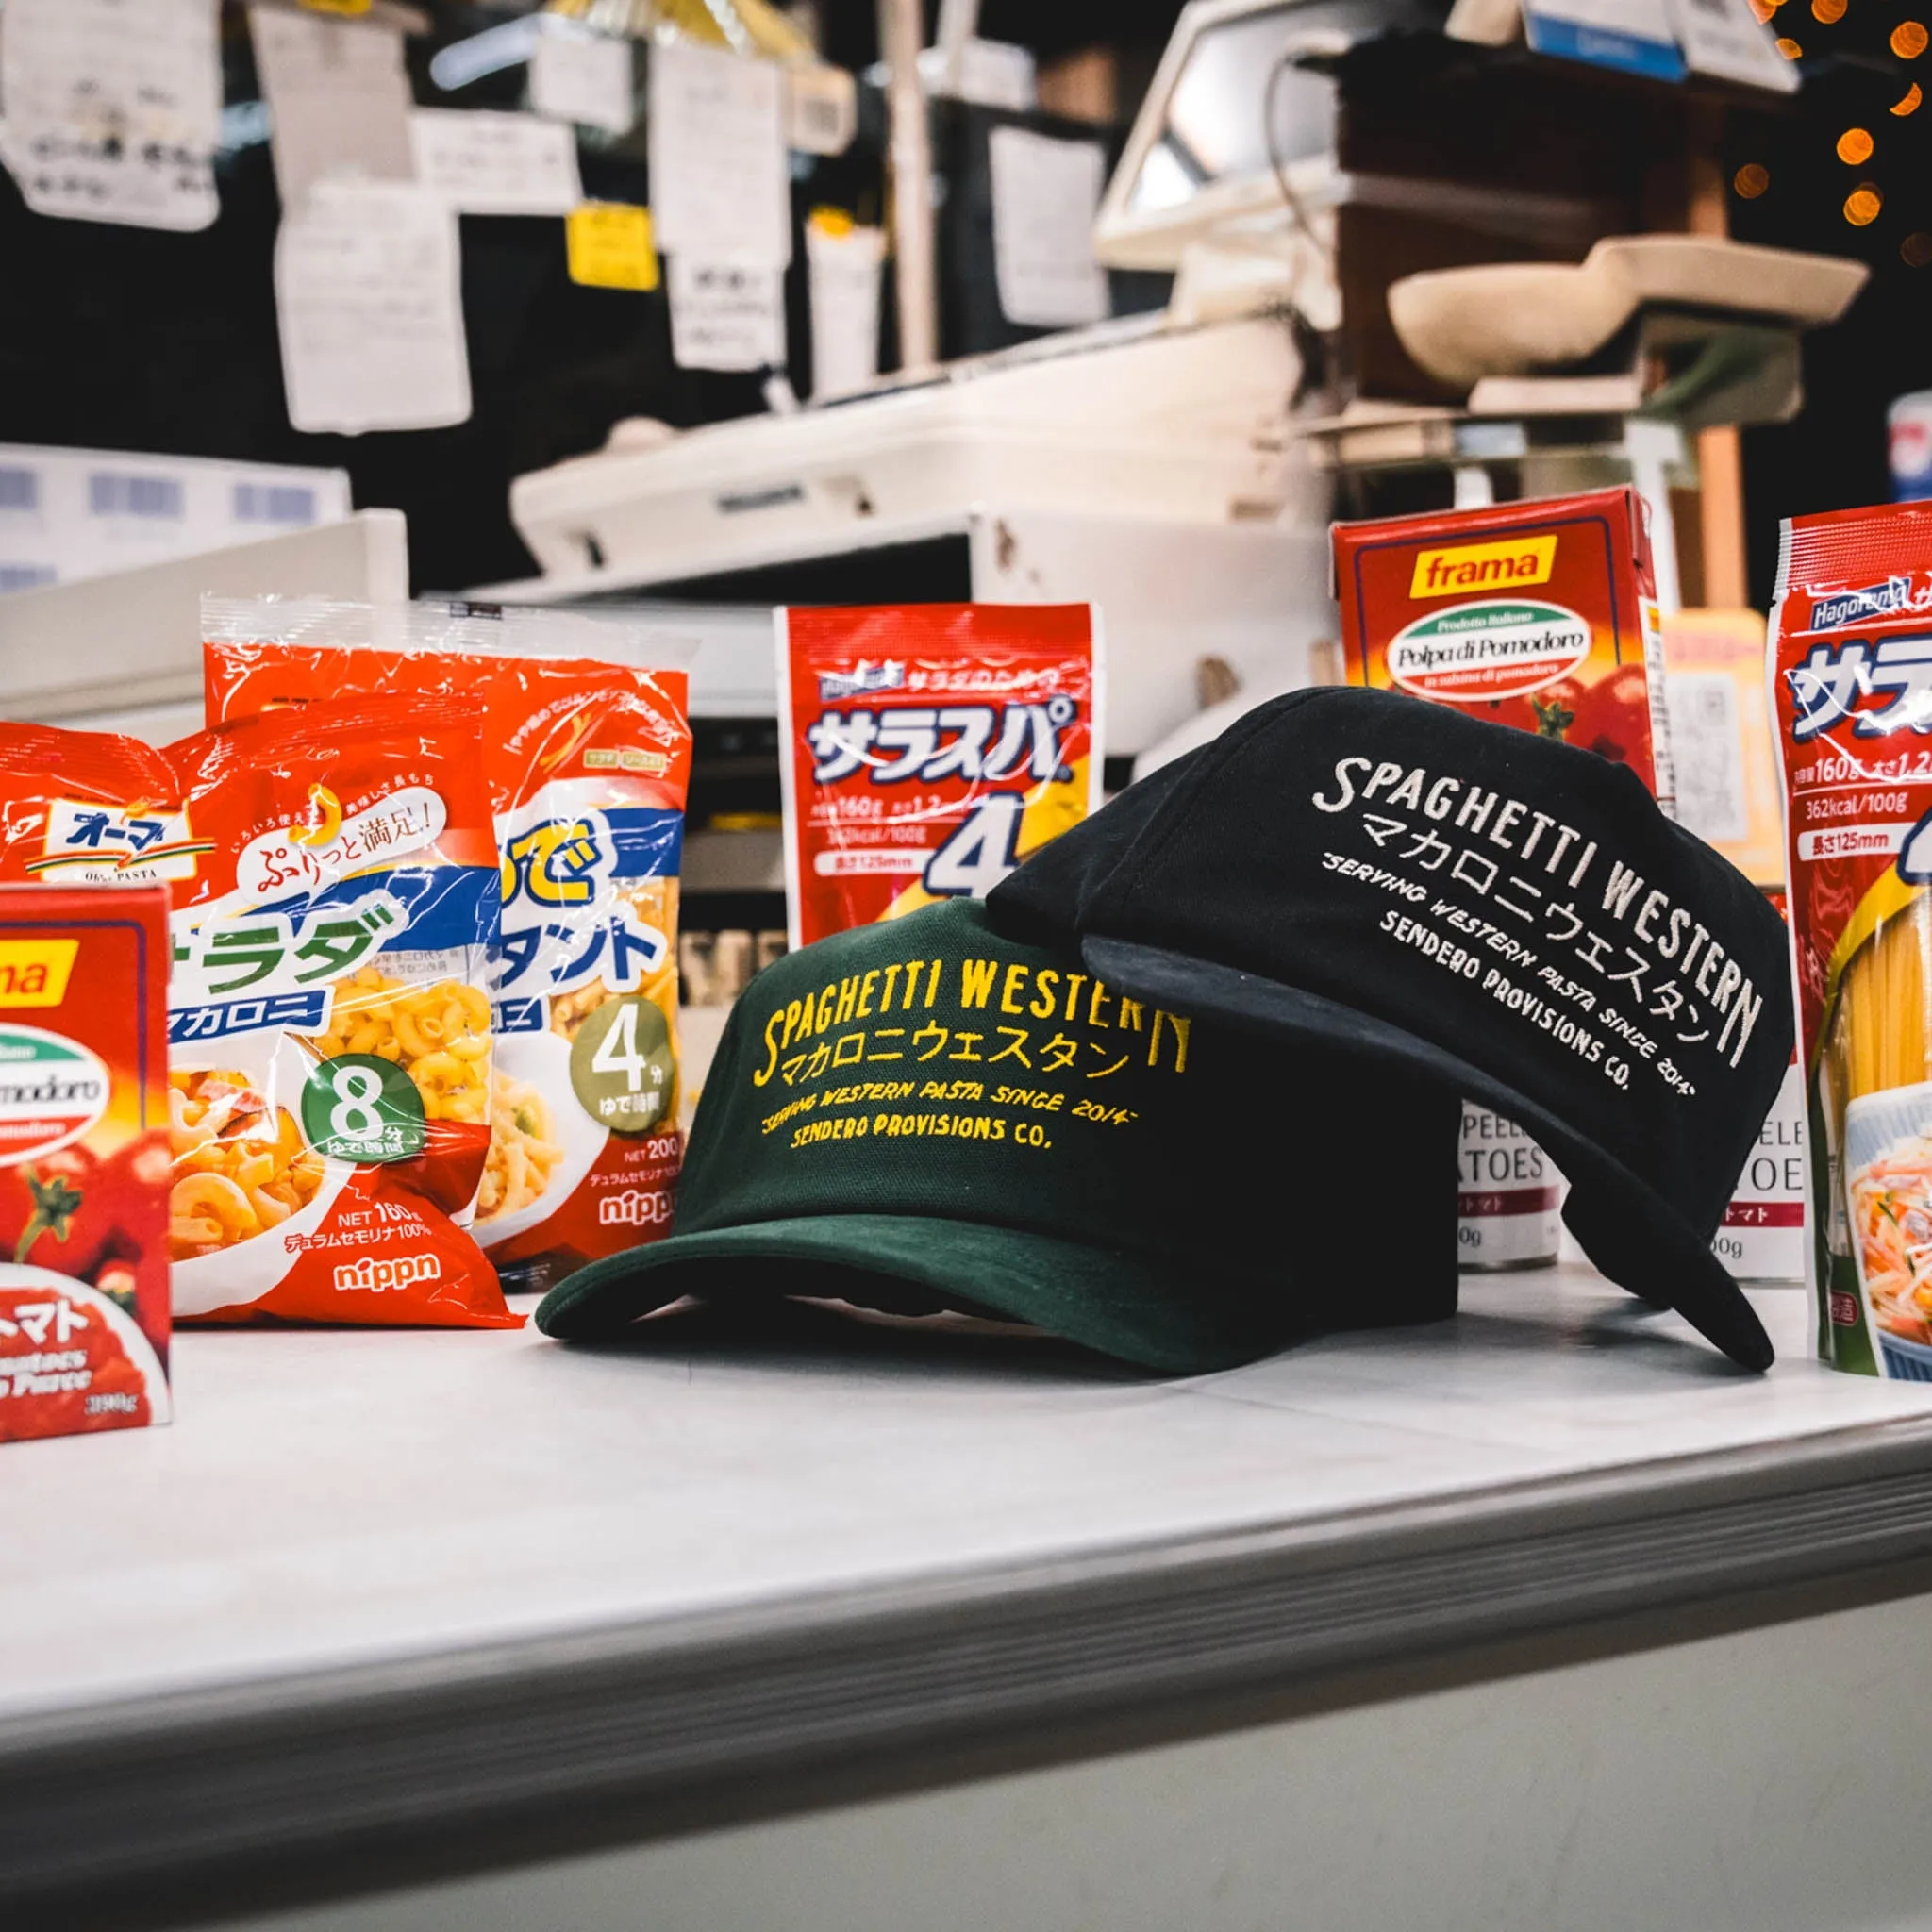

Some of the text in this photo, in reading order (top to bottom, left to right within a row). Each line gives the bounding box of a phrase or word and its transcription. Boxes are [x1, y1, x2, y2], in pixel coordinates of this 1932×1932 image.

[1426, 553, 1540, 589] frama
[1438, 611, 1534, 633] Prodotto Italiano
[1398, 630, 1584, 672] Polpa di Pomodoro
[1424, 663, 1559, 688] in salsina di pomodoro
[1794, 643, 1932, 738] サラ
[808, 695, 1077, 783] サラスパ
[1806, 791, 1908, 821] 362kcal/100g
[924, 791, 1023, 898] 4
[117, 869, 158, 881] PASTA
[1312, 757, 1598, 889] SPAGHETTI
[1601, 860, 1764, 1069] WESTERN
[1430, 898, 1538, 968] WESTERN
[1537, 964, 1598, 1013] PASTA
[1598, 1008, 1658, 1058] SINCE
[1379, 910, 1630, 1091] SENDERO PROVISIONS CO.
[754, 959, 1191, 1087] SPAGHETTI WESTERN
[820, 1081, 915, 1108] WESTERN
[919, 1081, 982, 1102] PASTA
[990, 1085, 1065, 1112] SINCE
[790, 1114, 1053, 1149] SENDERO PROVISIONS CO.
[1463, 1114, 1526, 1140] PEEL
[624, 1149, 646, 1163] NET
[1458, 1147, 1543, 1183] TOES
[1734, 1157, 1803, 1191] OE
[339, 1211, 372, 1227] NET
[599, 1190, 674, 1225] nipp
[334, 1254, 441, 1292] nippn
